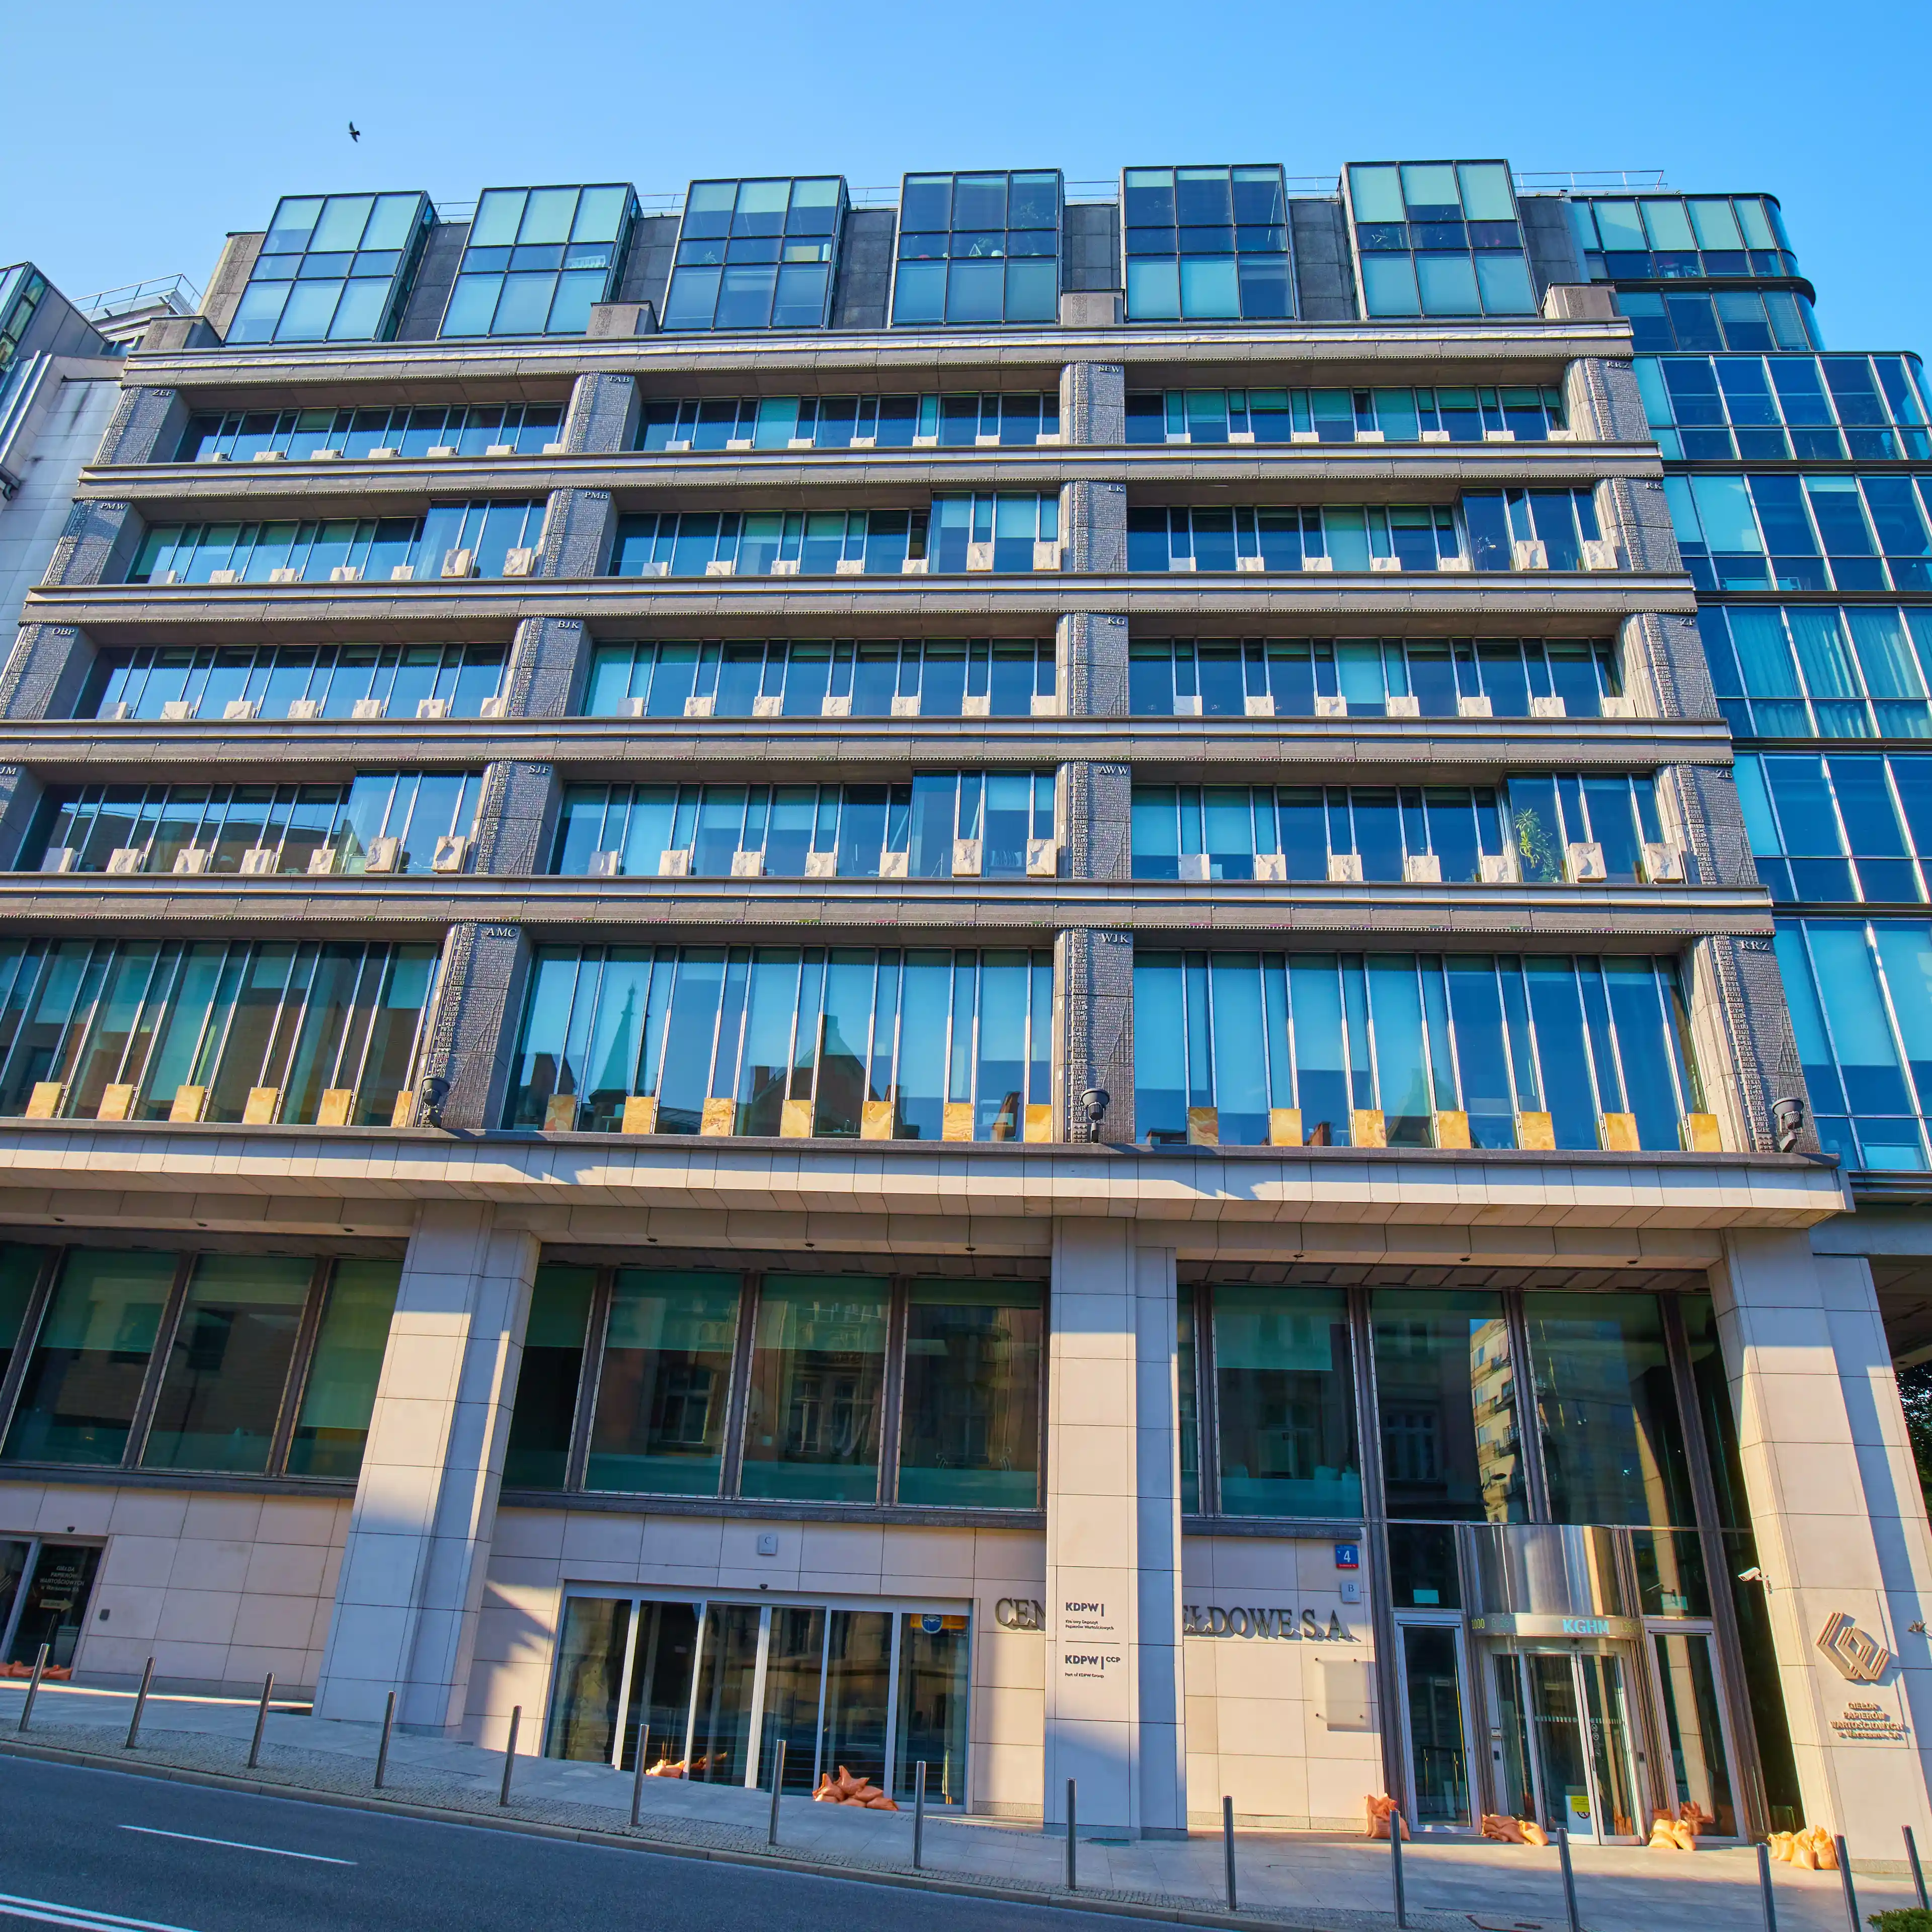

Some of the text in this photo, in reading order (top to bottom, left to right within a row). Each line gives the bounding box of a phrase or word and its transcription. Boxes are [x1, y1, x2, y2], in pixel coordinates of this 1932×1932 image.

[558, 620, 579, 628] BJK
[529, 765, 549, 773] SJF
[1099, 765, 1129, 775] AWW
[487, 927, 517, 937] AMC
[1101, 933, 1128, 943] WJK
[1741, 940, 1769, 950] RRZ
[1344, 1550, 1351, 1562] 4
[1348, 1584, 1354, 1592] B
[1065, 1602, 1099, 1612] KDPW
[1562, 1619, 1609, 1634] KGHM
[1065, 1655, 1098, 1664] KDPW
